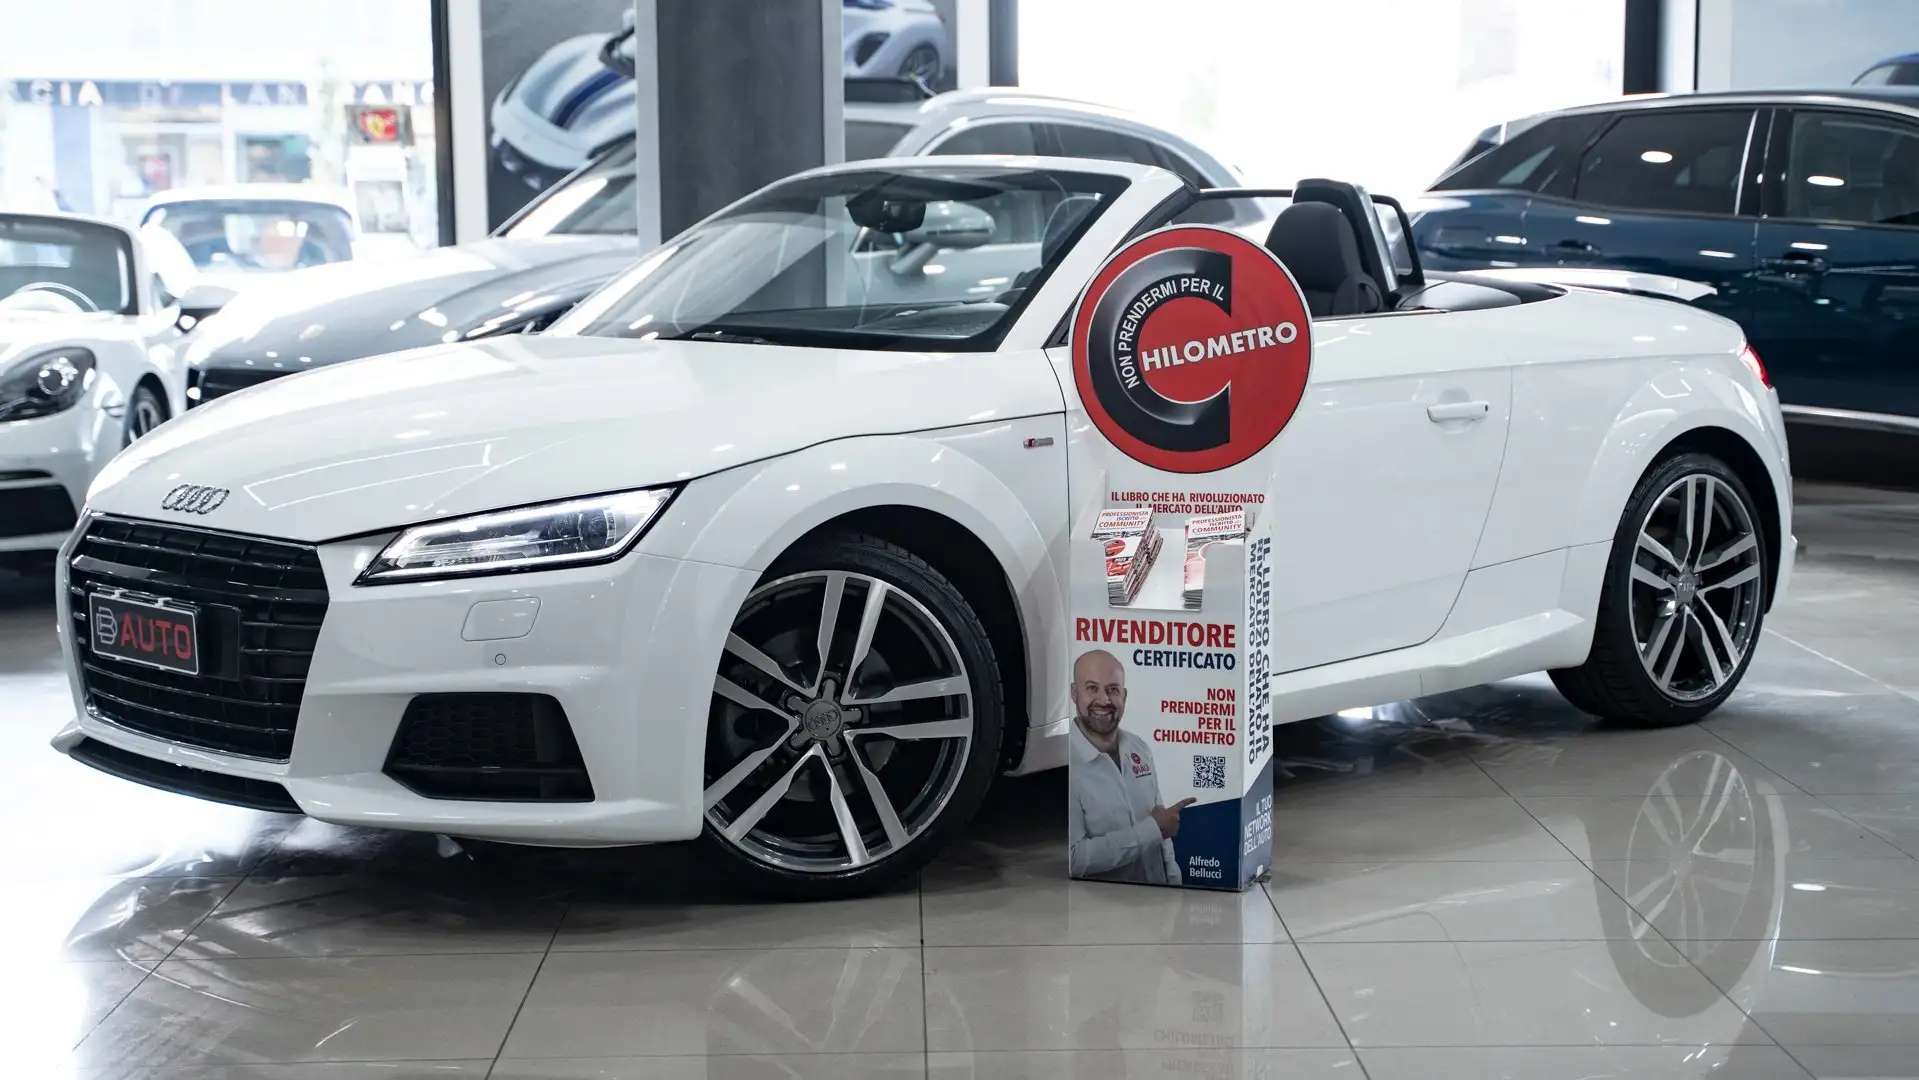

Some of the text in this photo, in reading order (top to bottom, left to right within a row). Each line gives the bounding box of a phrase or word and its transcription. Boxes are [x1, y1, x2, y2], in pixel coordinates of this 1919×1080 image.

[1118, 278, 1225, 389] NON PRENDERMI PER IL
[1111, 492, 1265, 504] IL LIBRO CHE HA RIVOLUZIONATO
[1148, 504, 1192, 514] MERCATO
[1194, 504, 1243, 515] DELL'AUTO
[1192, 514, 1242, 524] PROFESSIONISTA
[1192, 524, 1242, 533] COMMUNITY
[1249, 543, 1257, 647] MERCATO
[120, 612, 191, 660] AUTO
[1075, 617, 1236, 648] RIVENDITORE
[1262, 537, 1270, 753] IL LIBRO CHE HA
[1132, 649, 1236, 670] CERTIFICATO
[1207, 688, 1236, 702] NON
[1161, 701, 1236, 717] PRENDERMI
[1198, 717, 1236, 731] PER IL
[1153, 729, 1236, 746] CHILOMETRO
[1256, 737, 1262, 759] IL
[1261, 795, 1272, 812] TUO
[1244, 809, 1272, 839] NETWORK
[1189, 856, 1220, 867] Alfredo
[1189, 867, 1222, 879] Bellucci
